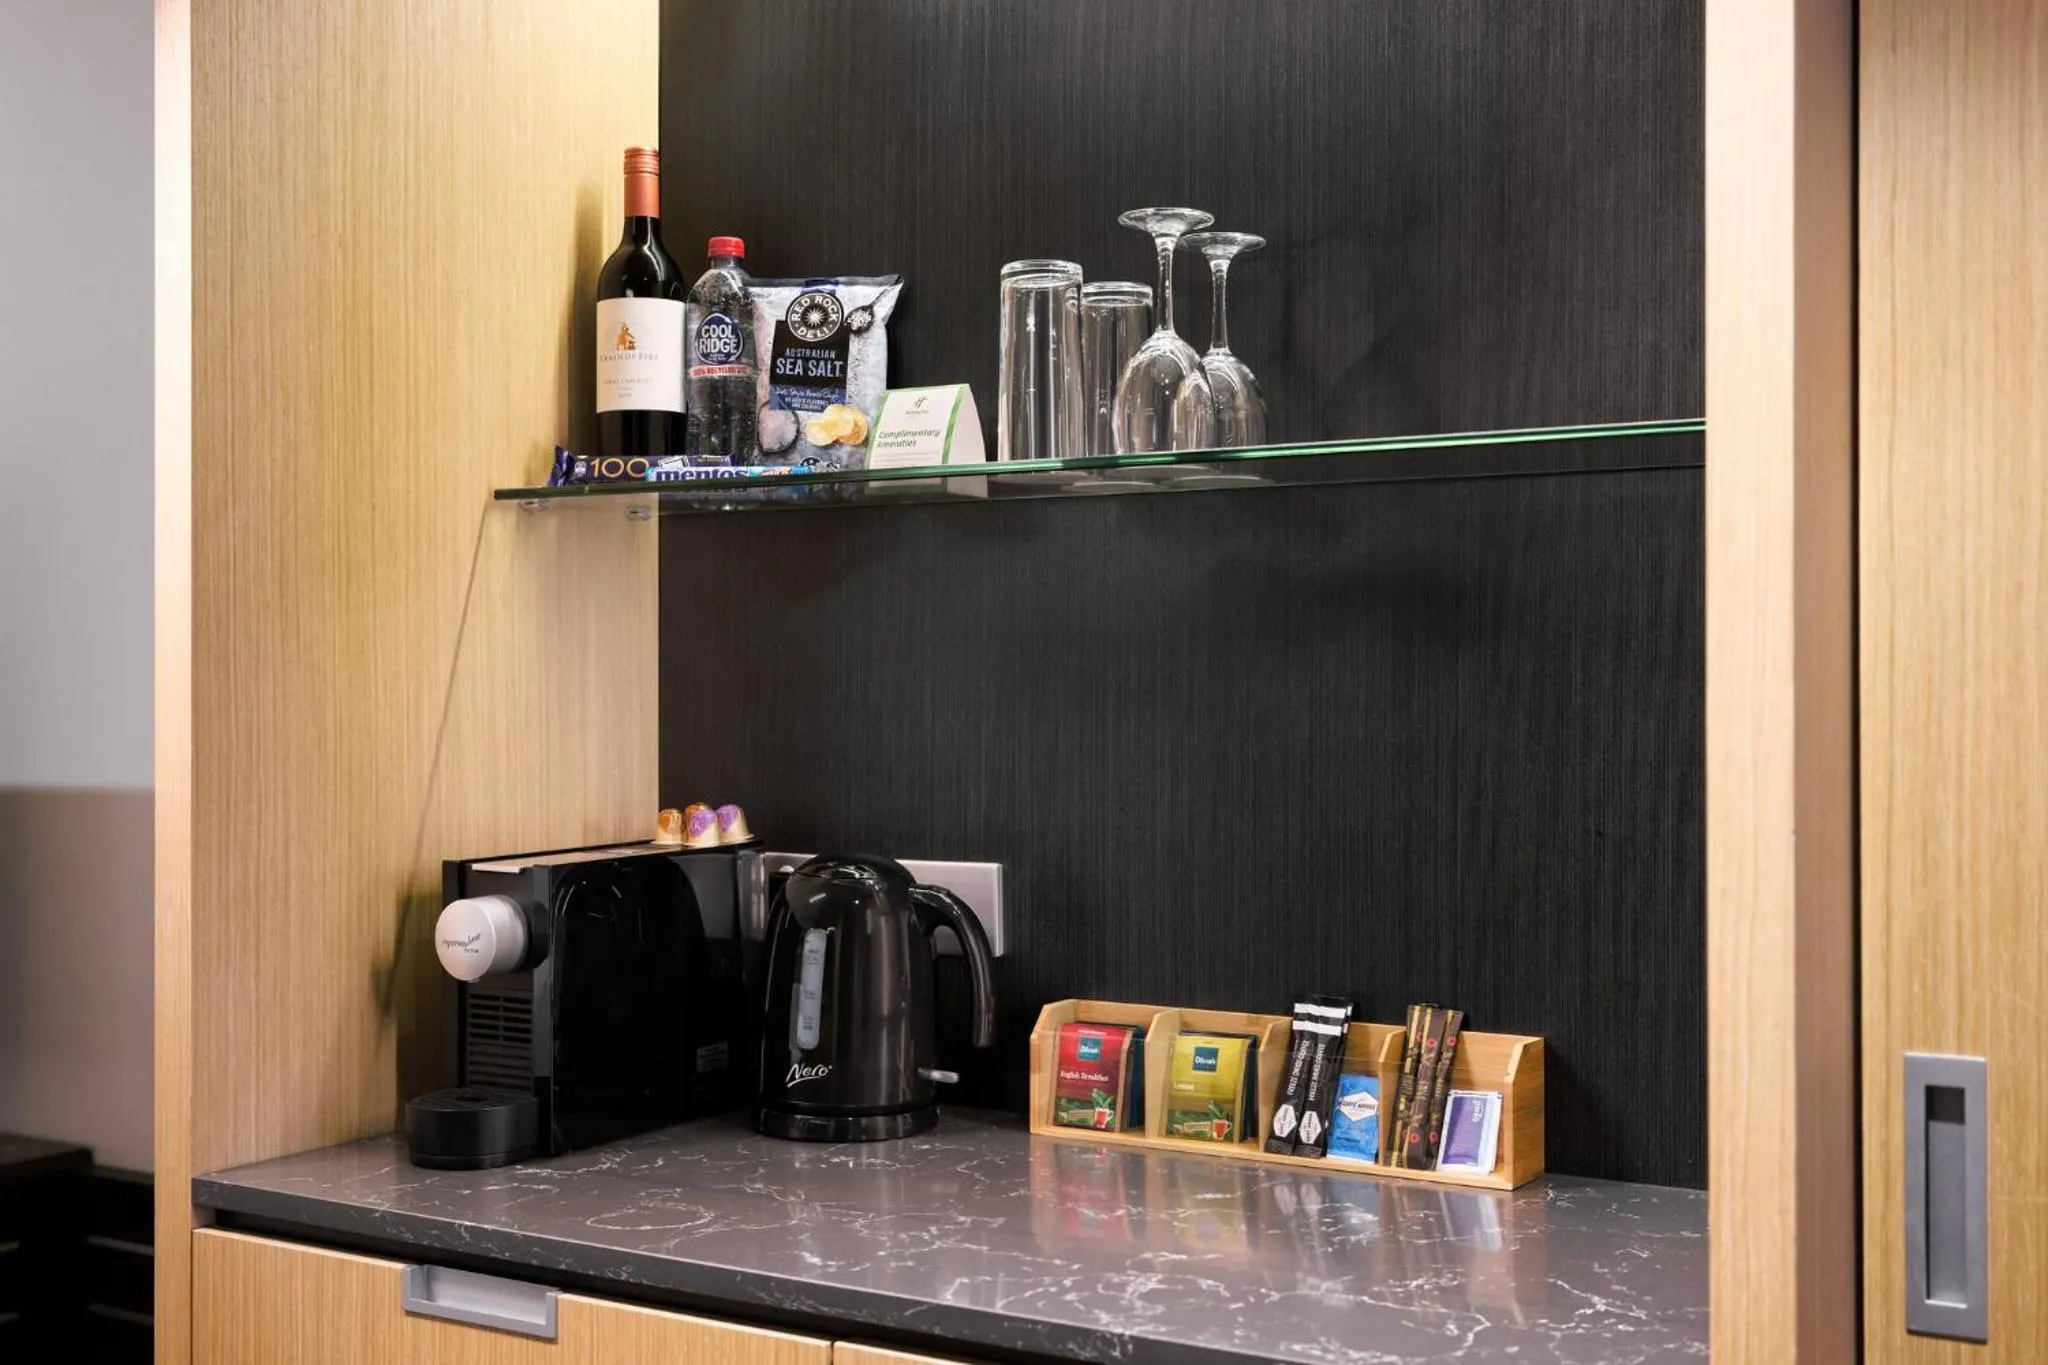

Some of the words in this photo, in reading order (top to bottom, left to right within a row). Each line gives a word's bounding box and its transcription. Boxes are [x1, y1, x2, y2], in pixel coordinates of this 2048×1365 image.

[791, 297, 811, 321] RED
[814, 296, 839, 322] ROCK
[701, 324, 736, 338] COOL
[797, 327, 830, 338] DELI
[700, 338, 738, 353] RIDGE
[784, 347, 837, 360] AUSTRALIAN
[776, 357, 804, 376] SEA
[807, 359, 844, 378] SALT
[878, 429, 942, 440] Complimentary
[876, 439, 917, 449] Amenities
[655, 466, 748, 481] mentos
[785, 1062, 829, 1084] Nero
[1060, 1070, 1080, 1080] English
[1081, 1071, 1109, 1082] Breakfast
